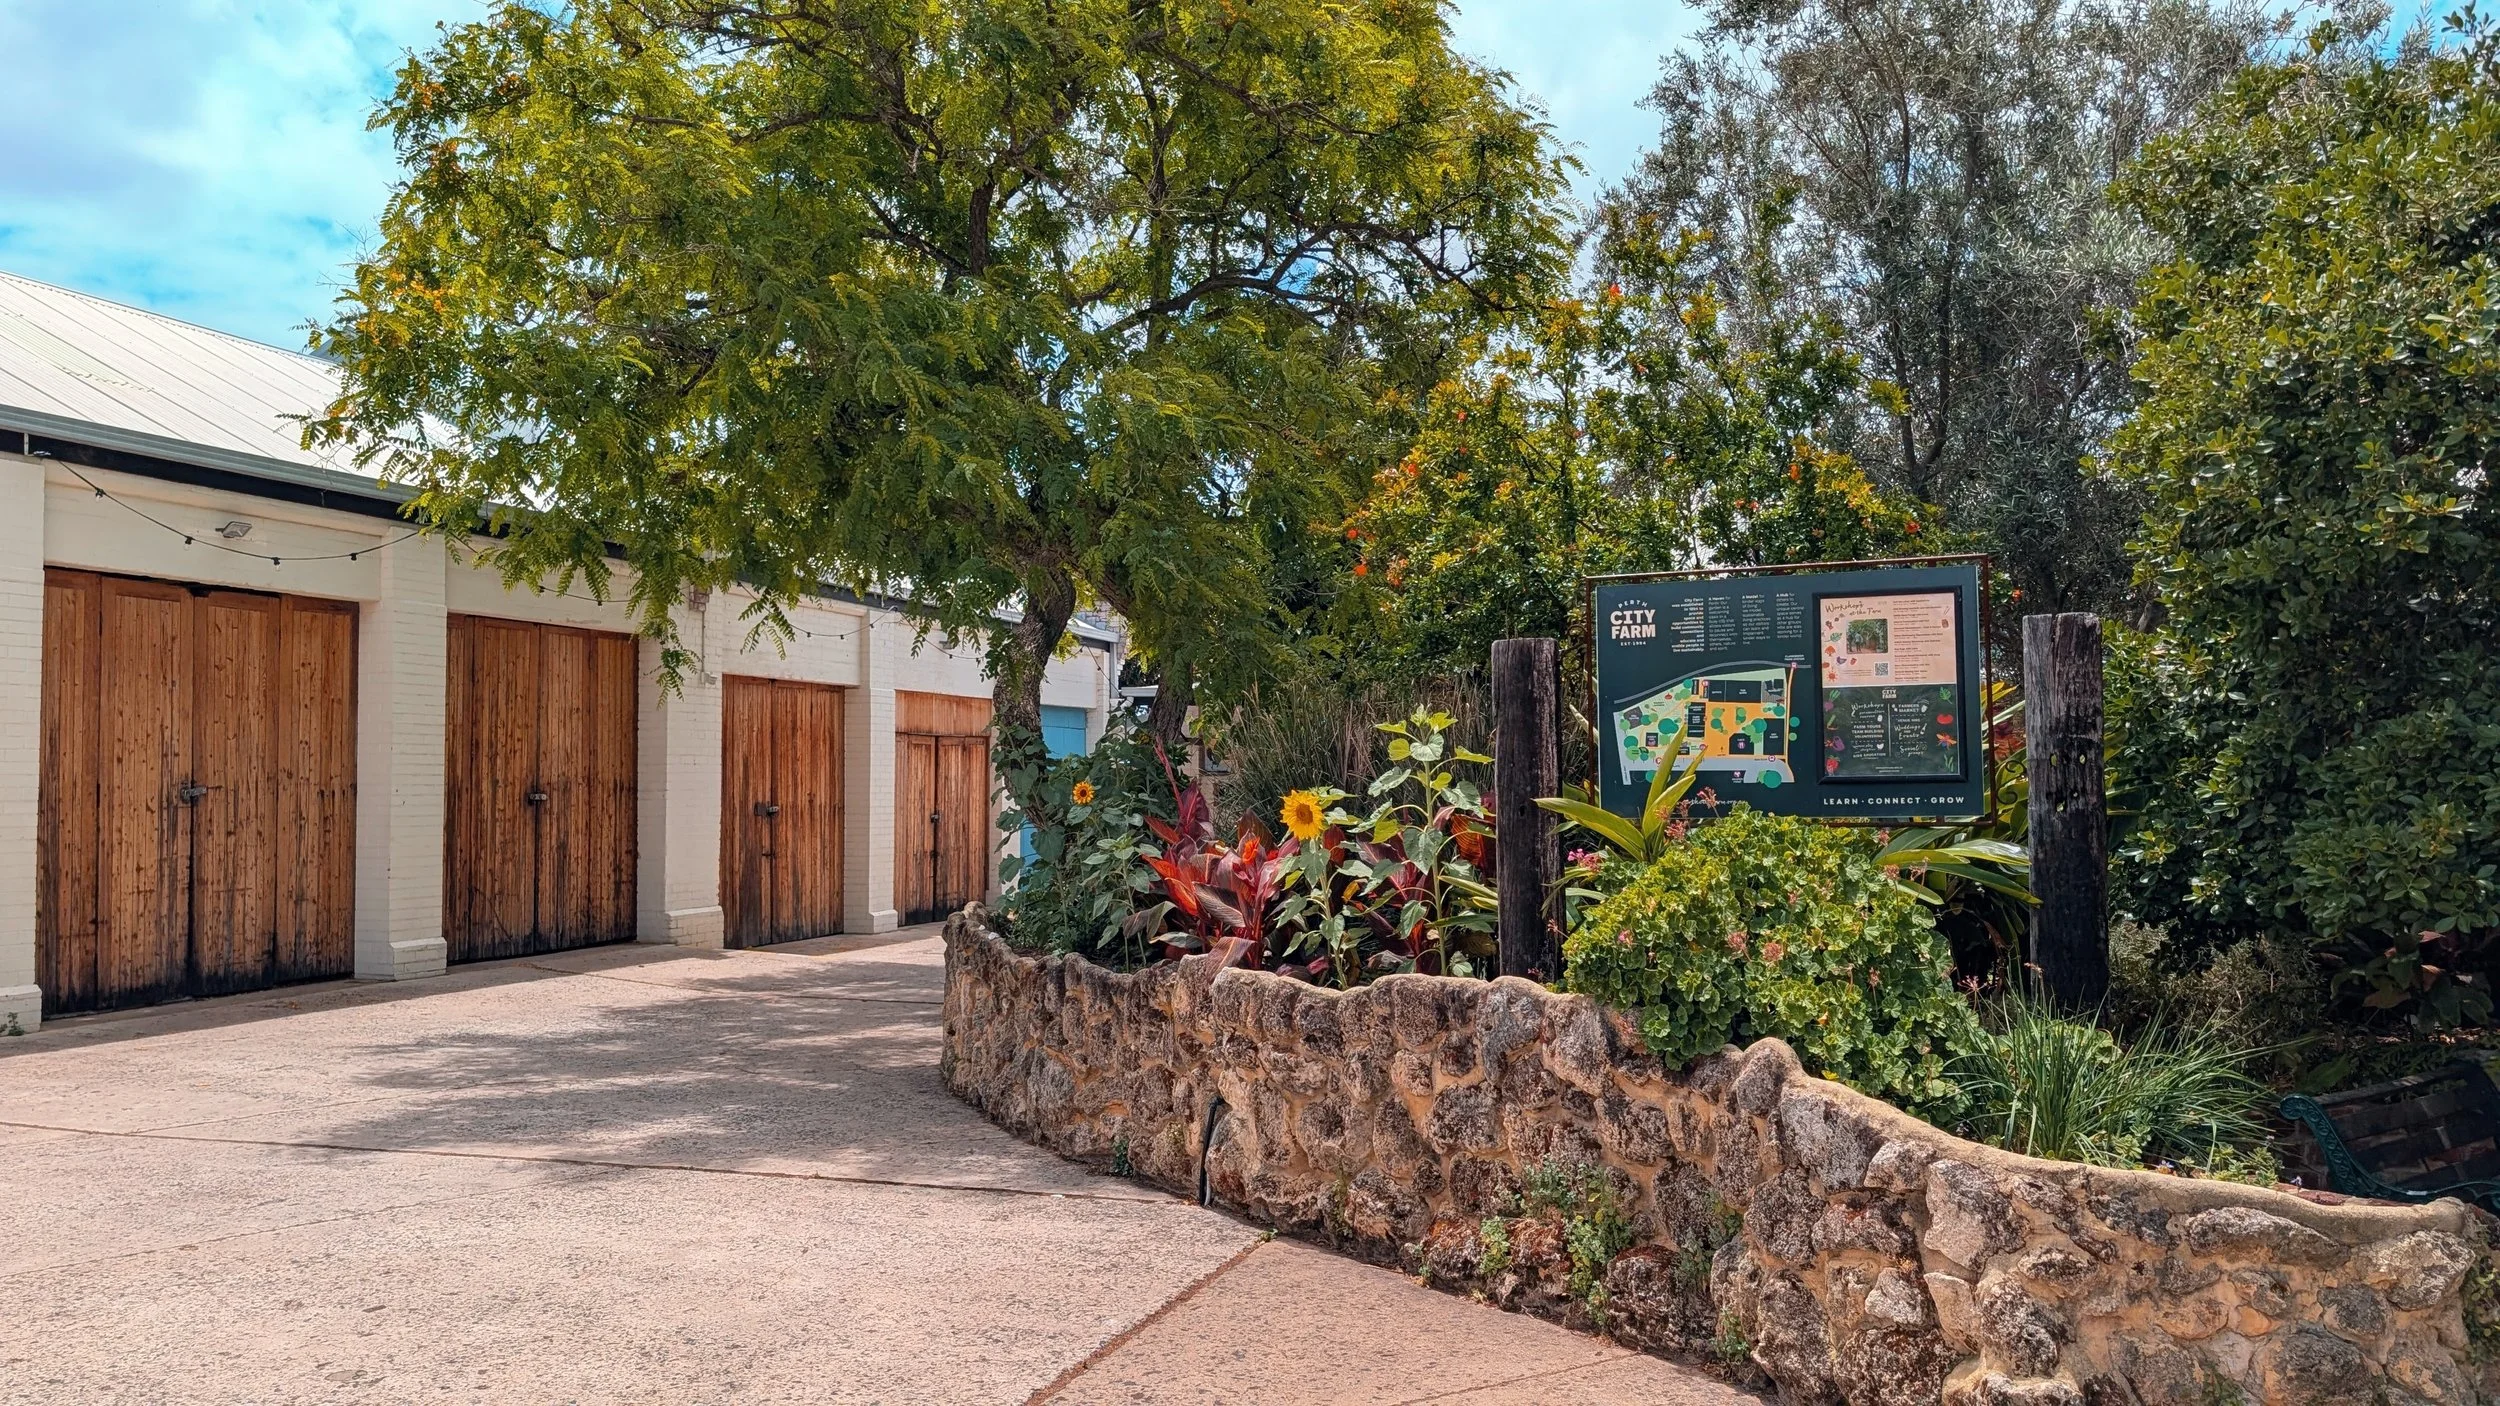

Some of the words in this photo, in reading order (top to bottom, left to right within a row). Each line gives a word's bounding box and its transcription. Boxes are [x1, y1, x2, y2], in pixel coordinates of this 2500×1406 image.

[1618, 600, 1648, 609] PERTH
[1826, 601, 1865, 613] Workshops
[1610, 609, 1656, 625] CITY
[1612, 624, 1656, 640] FARM
[1868, 797, 1920, 805] CONNECT
